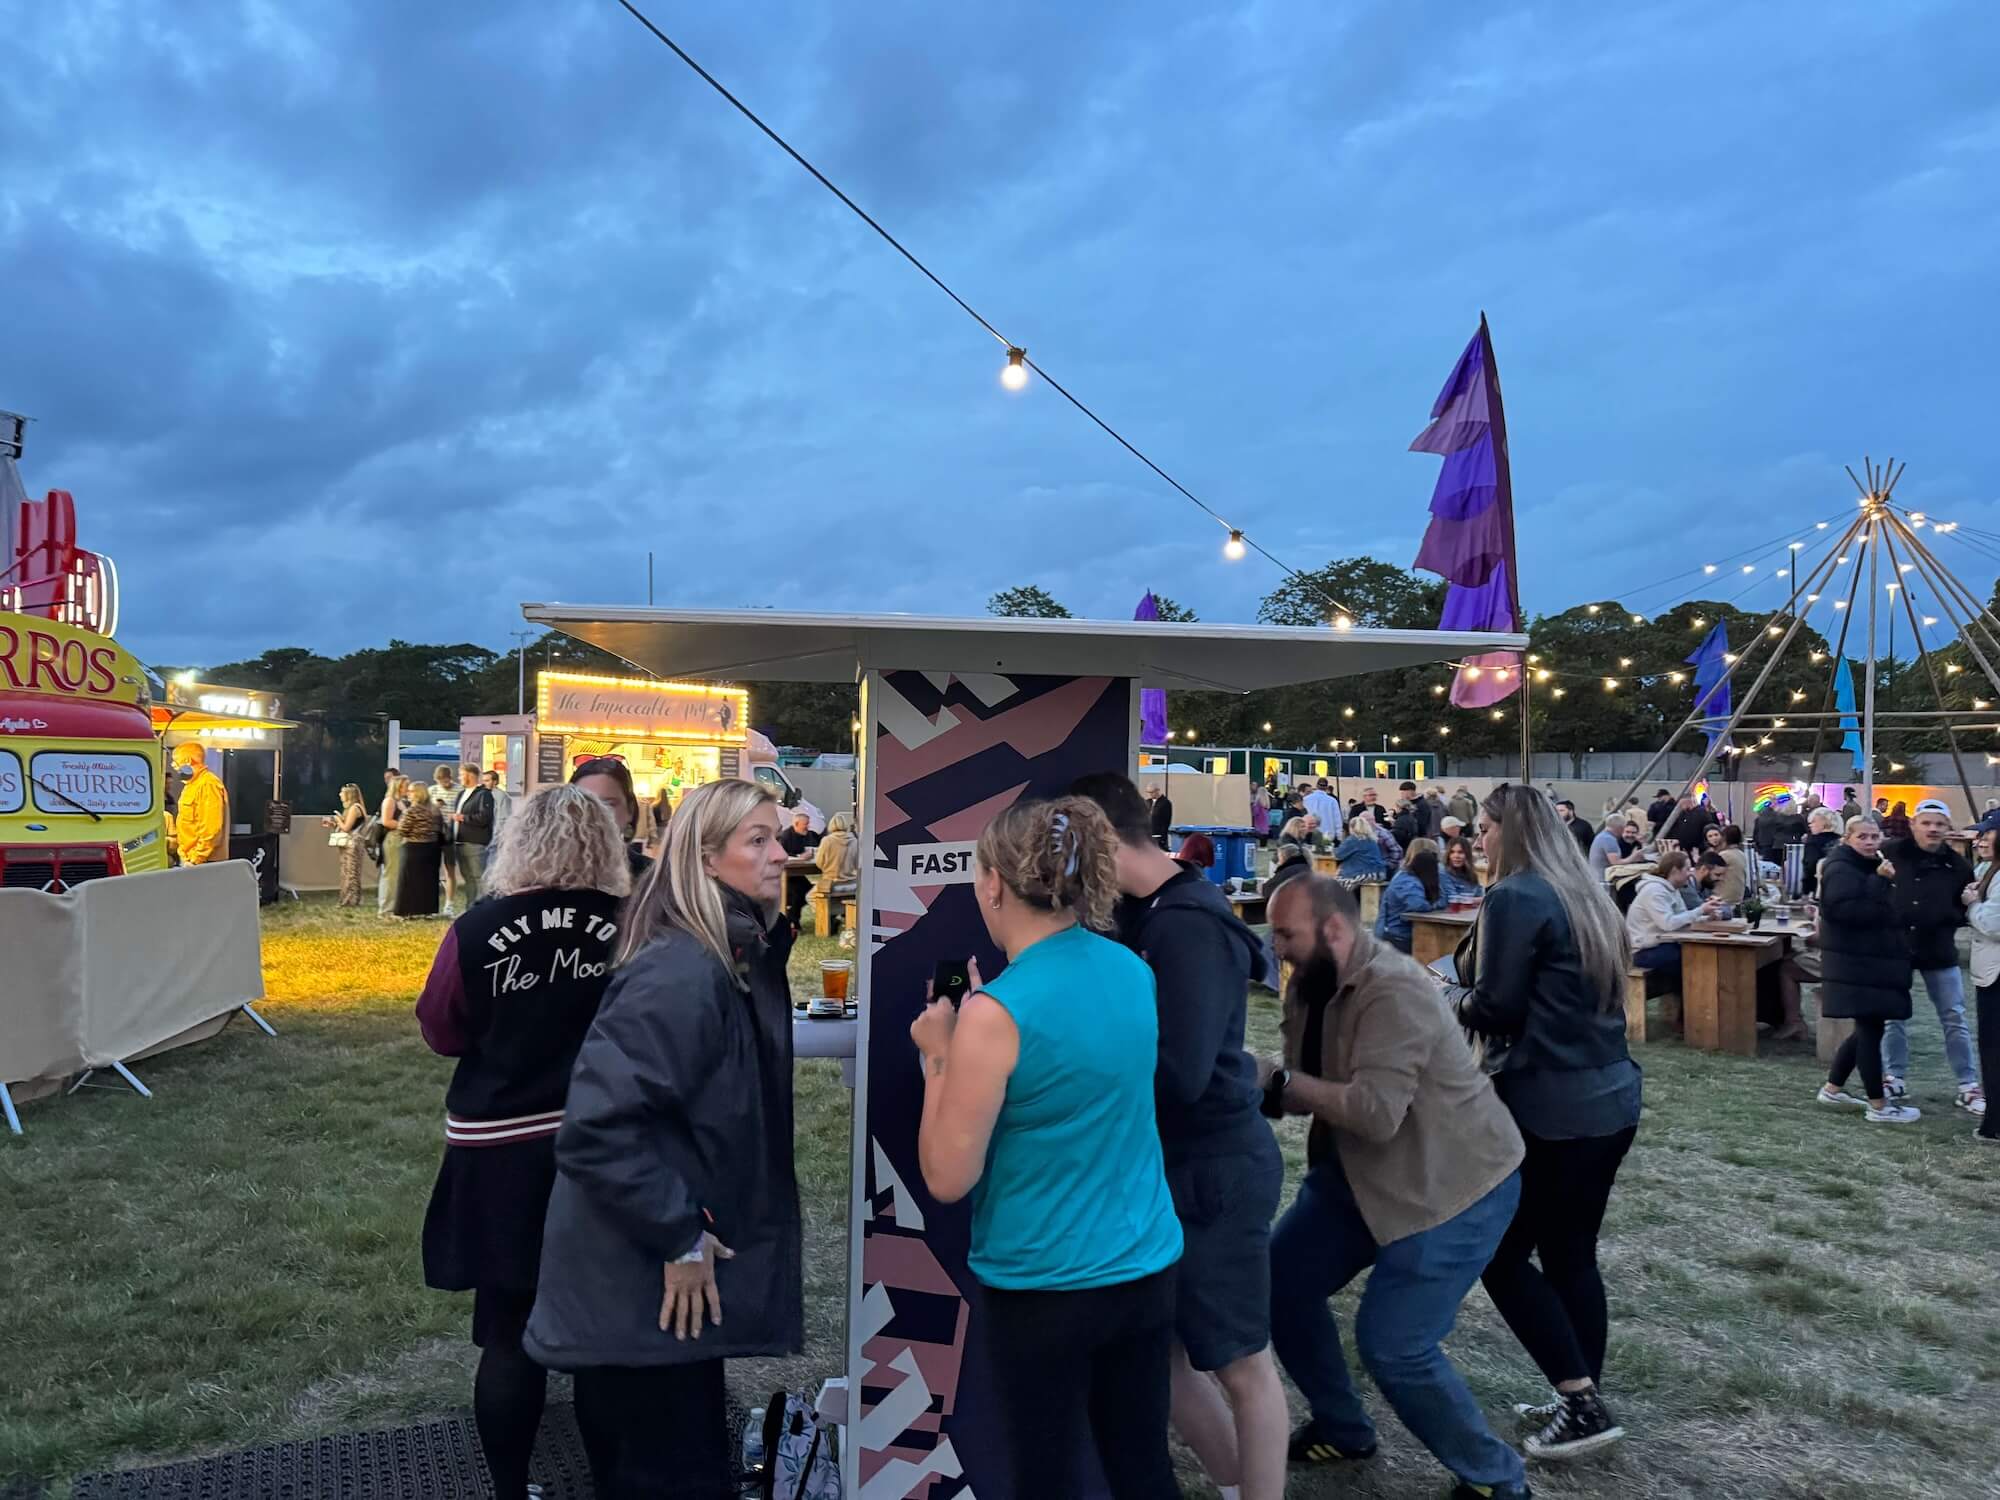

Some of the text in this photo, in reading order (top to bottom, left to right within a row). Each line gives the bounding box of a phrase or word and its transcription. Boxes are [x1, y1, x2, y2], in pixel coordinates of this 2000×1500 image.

[558, 692, 581, 710] The
[590, 694, 672, 720] Impeccable
[41, 773, 147, 794] CHURROS
[911, 851, 972, 875] FAST
[488, 907, 617, 952] FLY ME TO
[483, 948, 606, 997] The Moo
